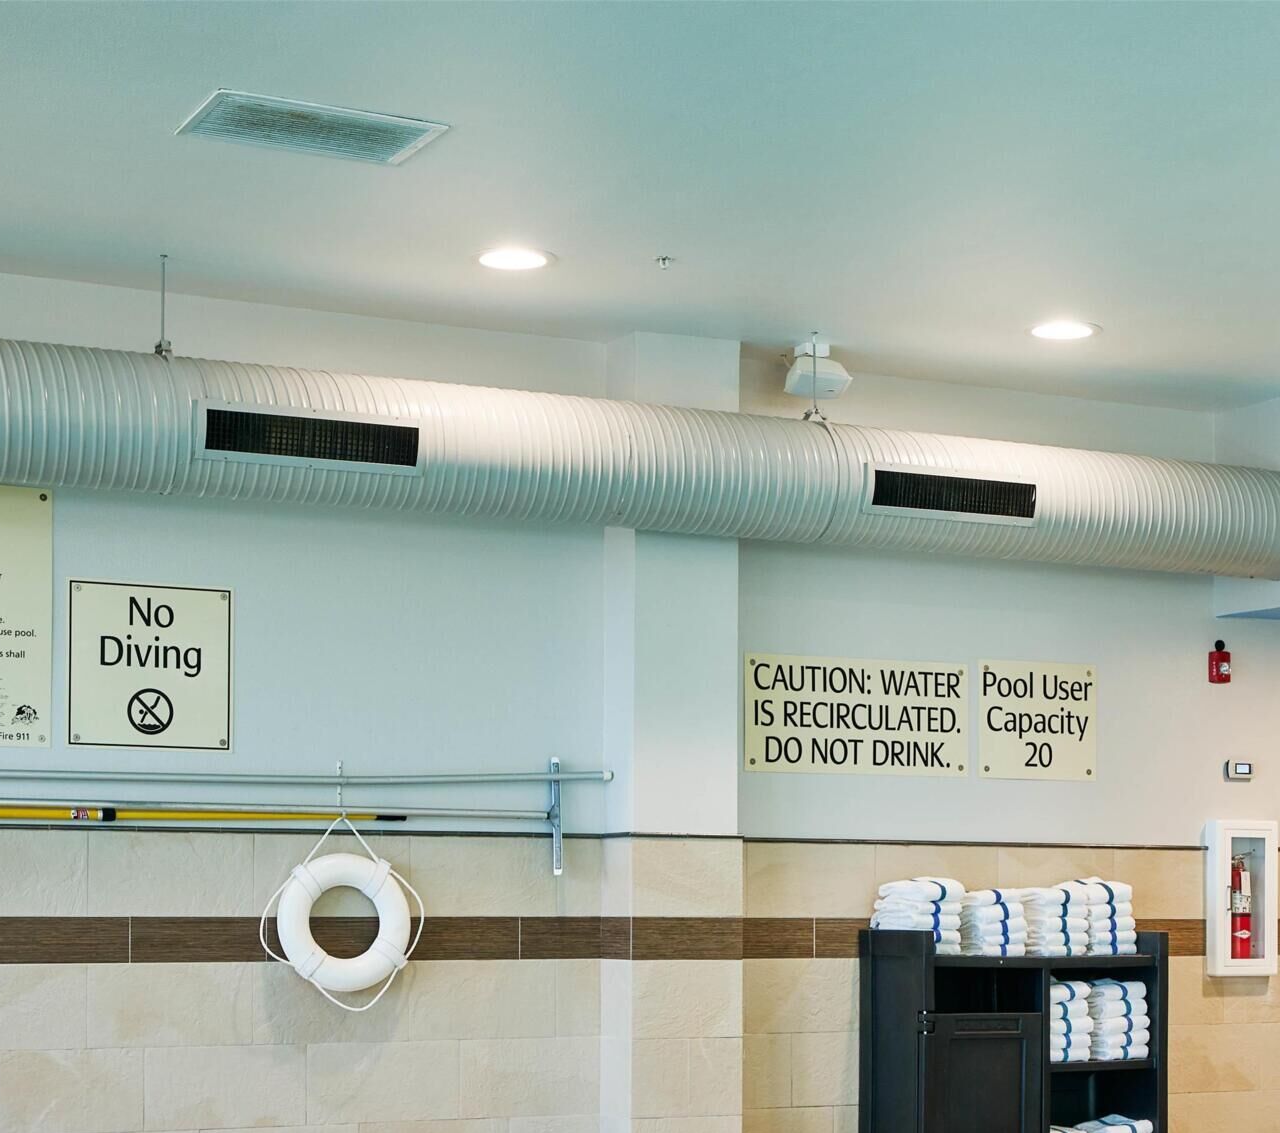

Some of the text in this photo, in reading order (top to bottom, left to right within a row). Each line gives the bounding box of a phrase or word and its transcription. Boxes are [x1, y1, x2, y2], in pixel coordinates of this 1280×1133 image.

[129, 597, 174, 628] No
[14, 628, 37, 638] pool.
[5, 649, 26, 658] shall
[100, 635, 202, 678] Diving
[753, 663, 961, 699] CAUTION: WATER
[982, 671, 1093, 701] Pool User
[754, 699, 961, 734] IS RECIRCULATED.
[986, 706, 1089, 742] Capacity
[16, 732, 30, 740] 911
[765, 736, 951, 769] DO NOT DRINK.
[1024, 742, 1053, 768] 20
